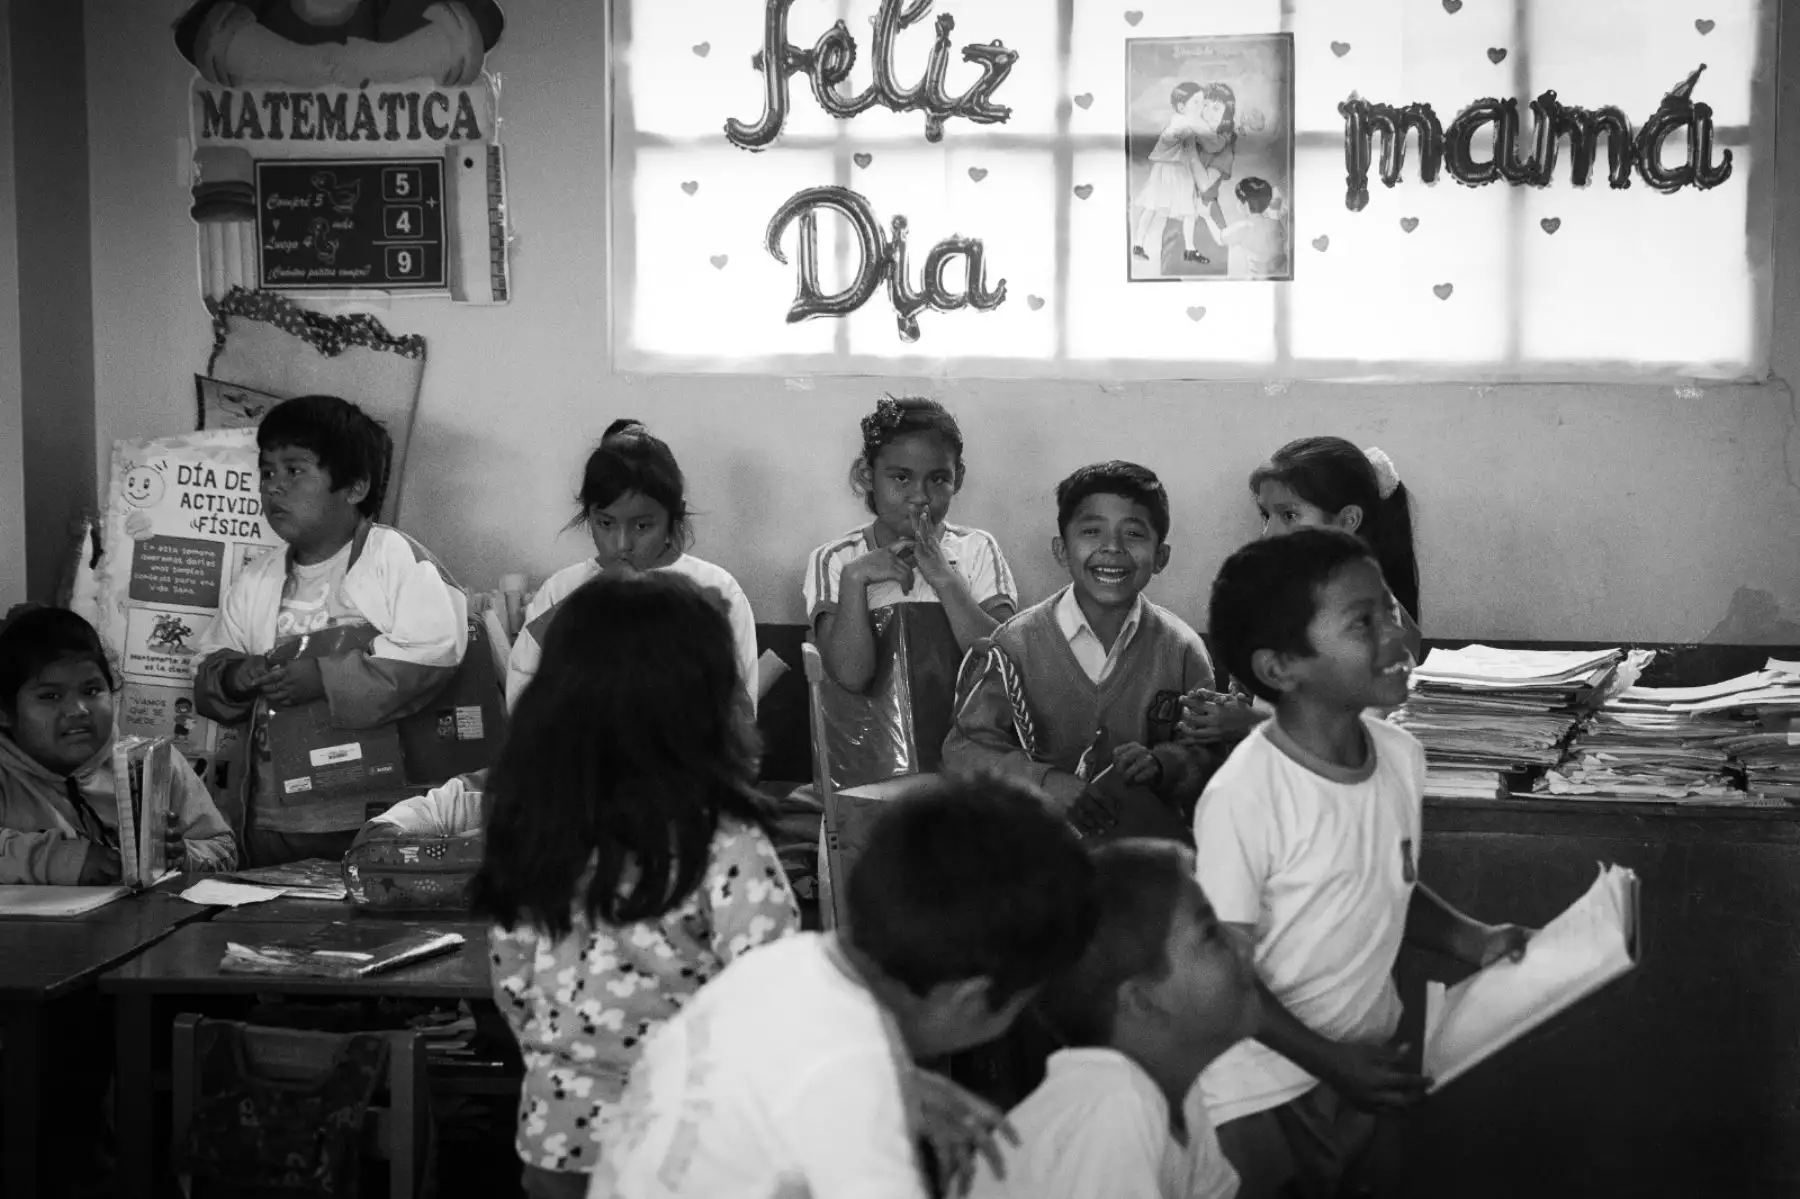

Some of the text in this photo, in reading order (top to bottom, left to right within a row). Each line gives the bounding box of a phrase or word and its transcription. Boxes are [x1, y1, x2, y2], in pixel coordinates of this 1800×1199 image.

[199, 77, 482, 141] MATEMÁTICA
[395, 173, 410, 196] 5
[395, 210, 412, 234] 4
[397, 251, 413, 274] 9
[178, 462, 253, 492] DÍA DE
[180, 492, 263, 516] ACTIVID
[198, 512, 262, 539] FÍSICA
